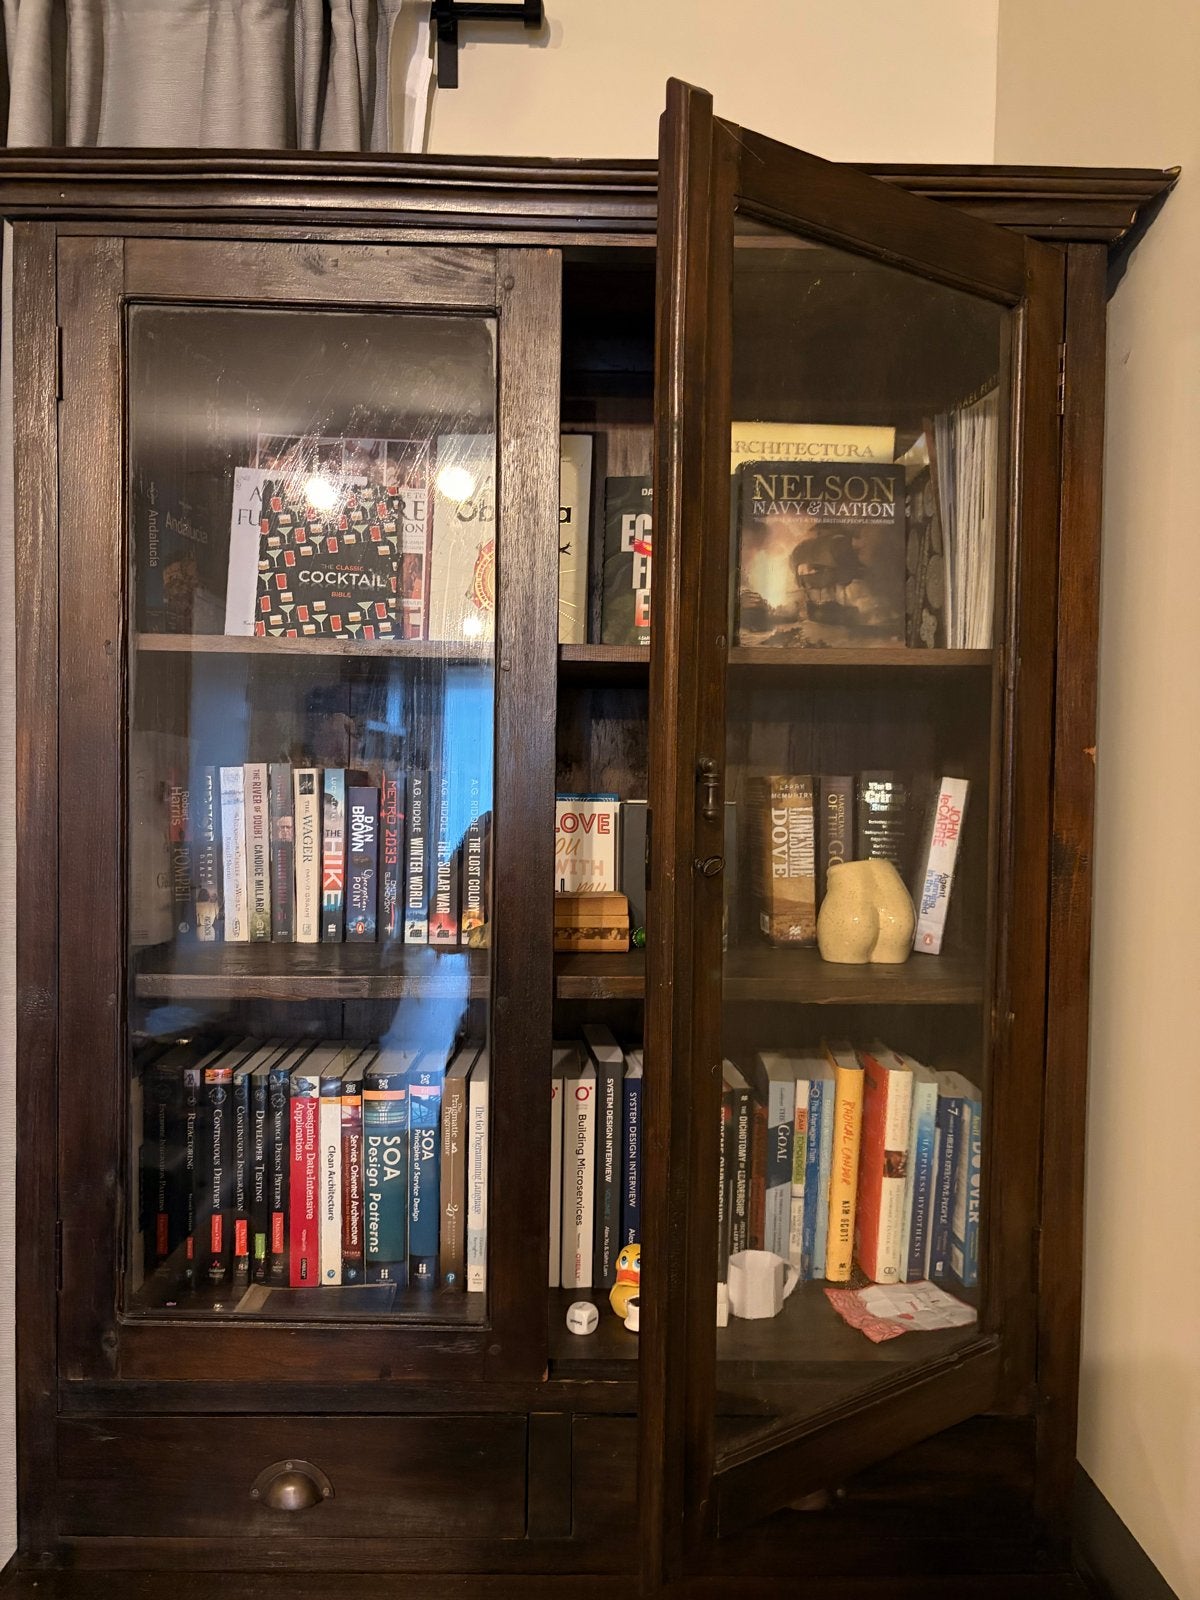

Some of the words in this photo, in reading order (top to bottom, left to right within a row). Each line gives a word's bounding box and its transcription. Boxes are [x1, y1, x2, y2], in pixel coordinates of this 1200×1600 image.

[732, 441, 874, 457] RCHITECTURA
[752, 474, 896, 501] NELSON
[753, 501, 803, 515] NAVY
[806, 502, 822, 516] &
[824, 502, 895, 516] NATION
[298, 570, 386, 587] COCKTAIL
[252, 782, 262, 804] RIVER
[386, 780, 398, 825] METRO
[412, 778, 421, 798] A.G.
[440, 778, 448, 798] A.G.
[470, 778, 478, 798] A.G.
[828, 794, 838, 811] OF
[171, 787, 182, 826] Harris
[182, 791, 190, 820] Robert
[254, 806, 260, 814] OF
[412, 800, 421, 832] RIDDLE
[440, 800, 449, 832] RIDDLE
[470, 800, 478, 832] RIDDLE
[837, 794, 845, 839] MAGICIANS
[254, 815, 262, 839] DOUBT
[303, 814, 314, 864] WAGER
[325, 830, 342, 838] THE
[352, 806, 364, 852] BROWN
[364, 816, 374, 842] DAN
[828, 814, 837, 839] THE
[946, 806, 961, 840] JOHN
[385, 828, 397, 864] 2033
[410, 837, 424, 873] WINTER
[438, 840, 451, 858] THE
[468, 836, 480, 853] THE
[772, 808, 788, 878] DOVE
[788, 806, 815, 878] LONESOME
[175, 848, 192, 903] POMPEII
[254, 844, 264, 876] CANDICE
[324, 838, 343, 908] HIKE
[437, 860, 450, 890] SOLAR
[468, 856, 480, 876] LOST
[256, 880, 264, 913] MILLARD
[352, 877, 360, 908] POINT
[410, 875, 424, 908] WORLD
[468, 878, 480, 913] COLONY
[924, 880, 935, 892] the
[928, 874, 942, 909] Running
[938, 872, 950, 898] Agent
[436, 892, 450, 914] WAR
[921, 894, 934, 914] Field
[606, 1078, 614, 1108] SYSTEM
[628, 1092, 638, 1124] SYSTEM
[274, 1110, 282, 1141] SERVICE
[305, 1102, 316, 1150] Designing
[450, 1094, 460, 1138] Pragmatic
[475, 1106, 484, 1119] The
[475, 1120, 484, 1130] Go
[605, 1110, 614, 1140] DESIGN
[798, 1110, 806, 1130] TEAM
[842, 1100, 855, 1144] RADICAL
[948, 1107, 958, 1116] 7
[186, 1112, 197, 1170] REFACTORING
[214, 1108, 222, 1165] CONTINUOUS
[236, 1106, 245, 1158] CONTINUOUS
[256, 1110, 265, 1160] DEVELOPER
[294, 1102, 304, 1162] Applications
[413, 1128, 421, 1160] Principles
[421, 1129, 434, 1160] SOA
[444, 1106, 452, 1156] Programmer
[576, 1114, 587, 1155] Building
[628, 1126, 637, 1158] DESIGN
[738, 1116, 748, 1162] DICHOTOMY
[776, 1124, 790, 1162] GOAL
[808, 1113, 818, 1146] Manager's
[944, 1134, 954, 1158] HIGHLY
[328, 1145, 336, 1168] Clean
[350, 1134, 360, 1199] Service-Oriented
[366, 1136, 382, 1187] Design
[383, 1136, 402, 1182] SOA
[414, 1162, 420, 1170] of
[471, 1131, 484, 1180] Programming
[604, 1140, 613, 1183] INTERVIEW
[794, 1134, 804, 1184] TOPOLOGIES
[842, 1147, 854, 1186] CANDOR
[918, 1138, 930, 1192] HAPPINESS
[213, 1168, 222, 1209] DELIVERY
[236, 1160, 244, 1211] INTEGRATION
[256, 1164, 264, 1202] TESTING
[274, 1172, 282, 1209] PATTERNS
[306, 1152, 316, 1220] Data-Intensive
[576, 1158, 586, 1226] Microservices
[628, 1160, 636, 1208] INTERVIEW
[736, 1170, 748, 1216] LEADERSHIP
[942, 1160, 952, 1196] EFFECTIVE
[328, 1170, 336, 1222] Architecture
[412, 1197, 420, 1222] Design
[446, 1202, 458, 1216] 20
[472, 1181, 484, 1215] Language
[842, 1200, 850, 1216] KIM
[940, 1197, 950, 1224] PEOPLE
[350, 1200, 360, 1245] Architecture
[368, 1192, 382, 1253] Patterns
[628, 1228, 636, 1244] Alex
[840, 1218, 850, 1242] SCOTT
[914, 1196, 924, 1258] HYPOTHESIS
[604, 1238, 610, 1246] Xu
